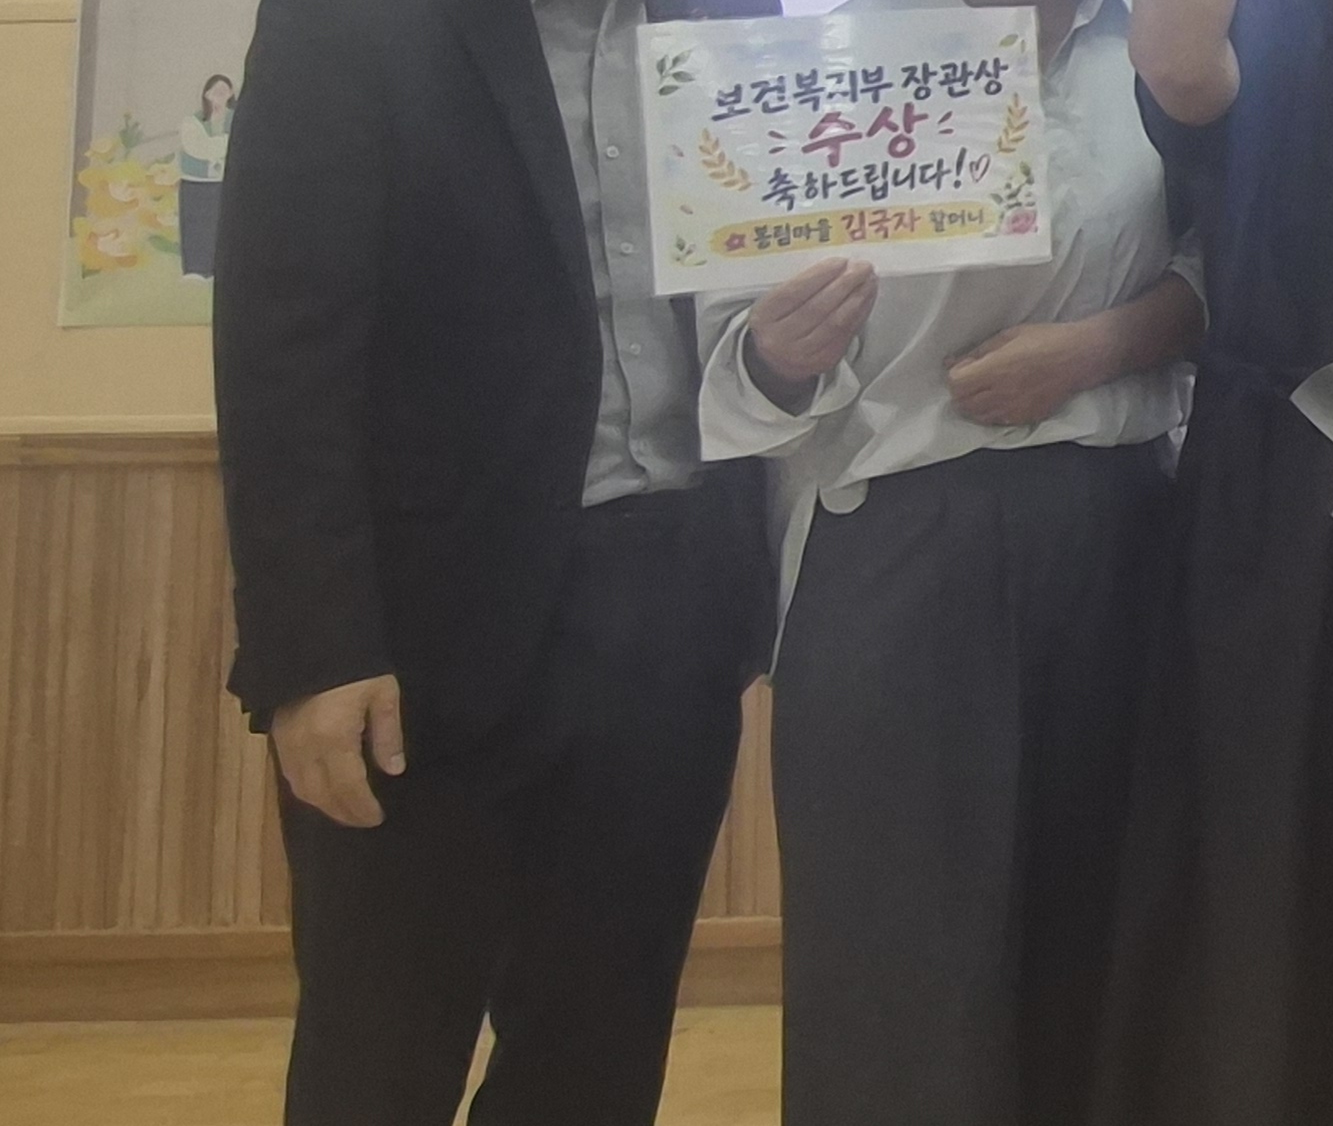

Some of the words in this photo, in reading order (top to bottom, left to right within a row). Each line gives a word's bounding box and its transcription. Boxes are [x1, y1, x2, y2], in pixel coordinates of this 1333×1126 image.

[711, 65, 892, 122] 보건복지부
[901, 57, 1009, 100] 장관상
[801, 102, 928, 167] 수상
[761, 147, 967, 211] 축하드립니다!
[840, 209, 921, 242] 김국자
[928, 210, 985, 234] 할머니
